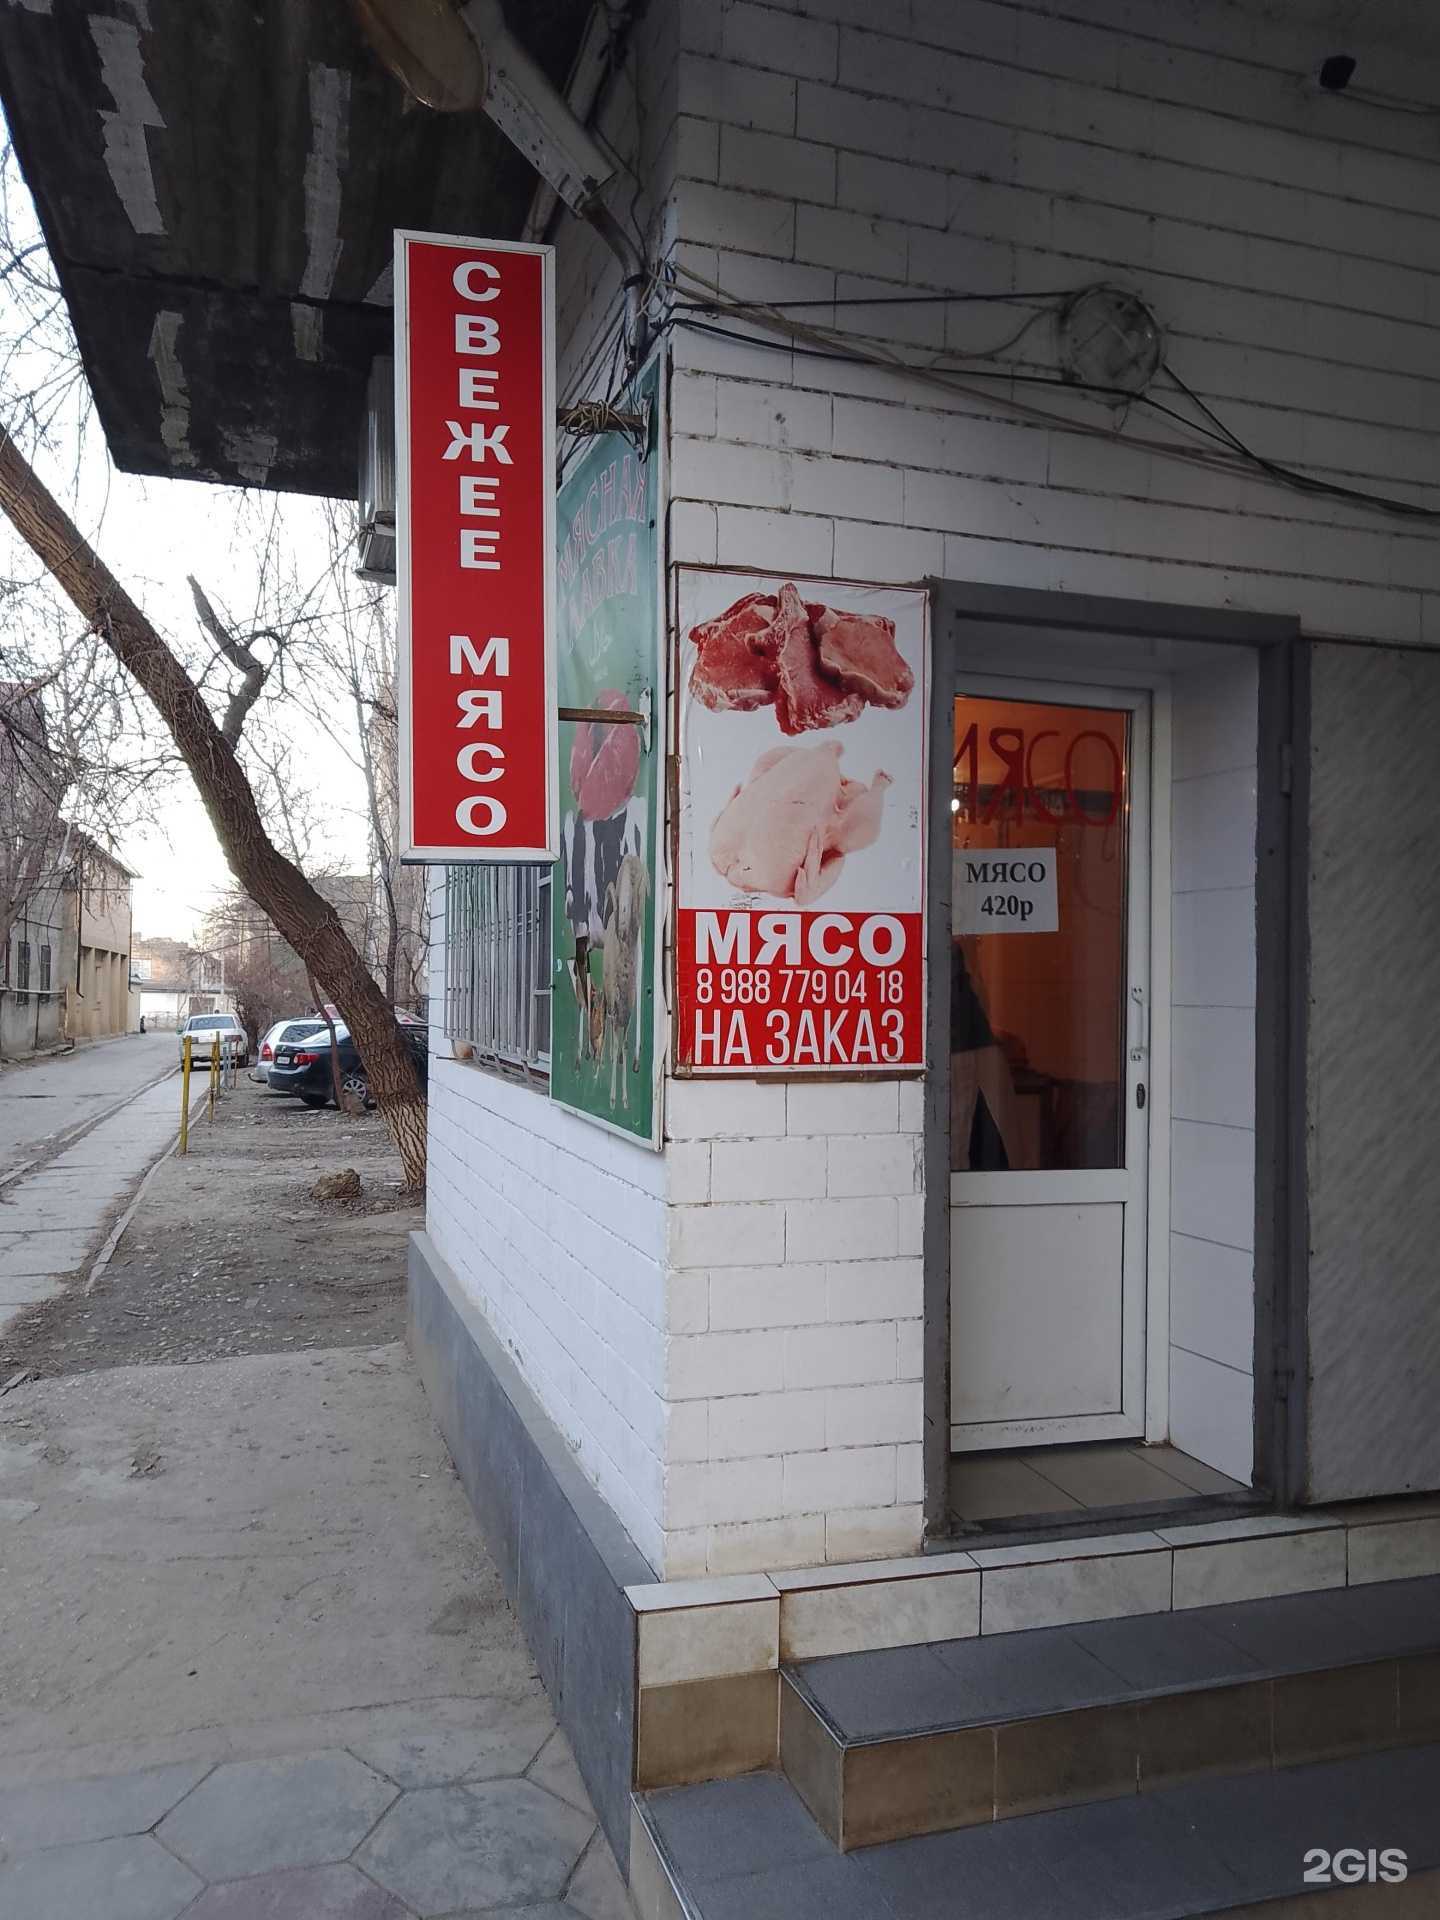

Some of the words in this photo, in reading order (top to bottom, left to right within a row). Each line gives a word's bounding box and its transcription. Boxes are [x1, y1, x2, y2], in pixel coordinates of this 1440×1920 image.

[442, 261, 514, 570] СВЕЖЕЕ
[450, 635, 510, 836] МЯСО
[967, 862, 1046, 883] МЯСО
[980, 895, 1034, 921] 420р
[695, 911, 906, 967] МЯСО
[696, 968, 713, 1004] 8
[720, 968, 771, 1004] 988
[778, 969, 827, 1004] 779
[835, 970, 867, 1003] 04
[876, 970, 904, 1004] 18
[694, 1009, 752, 1065] НА
[765, 1008, 904, 1064] ЗАКАЗ
